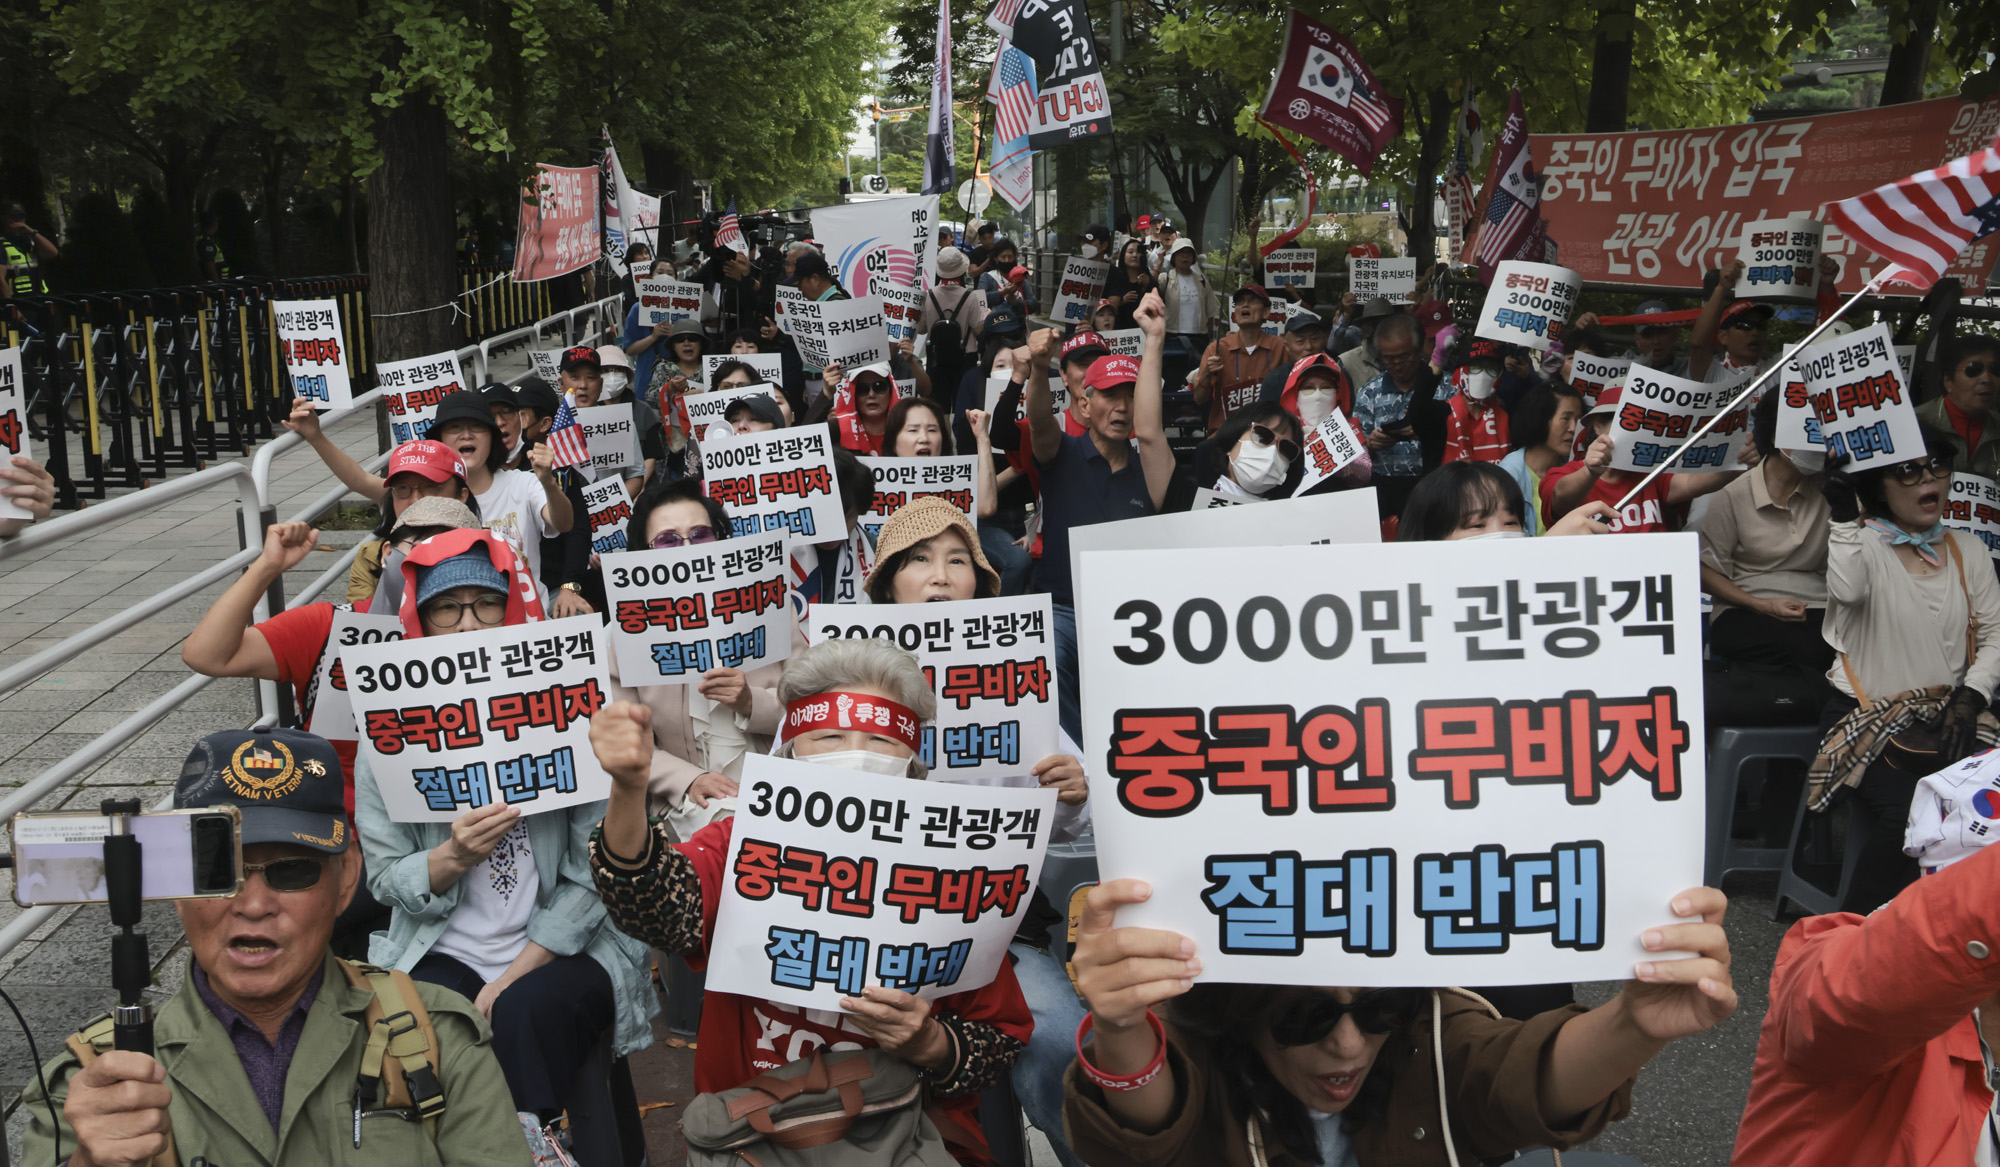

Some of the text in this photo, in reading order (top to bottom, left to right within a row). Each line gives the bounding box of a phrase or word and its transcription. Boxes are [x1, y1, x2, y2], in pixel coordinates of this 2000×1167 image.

[1541, 137, 1625, 202] 중국인
[1622, 130, 1726, 202] 무비자
[1723, 122, 1814, 199] 입국
[1603, 211, 1681, 279] 관광
[1751, 230, 1788, 248] 중국인
[1354, 260, 1379, 269] 중국인
[1755, 249, 1814, 264] 3000만명
[1354, 270, 1415, 280] 관광객 유치보다
[1354, 281, 1379, 291] 자국민
[1505, 273, 1549, 294] 중국인
[1747, 264, 1794, 286] 무비자
[641, 295, 701, 312] 중국인 무비자
[642, 284, 701, 297] 3000만 관광객
[295, 309, 334, 331] 관광객
[787, 301, 822, 319] 중국인
[883, 302, 905, 321] 국인
[1507, 292, 1572, 320] 3000만명
[792, 313, 884, 337] 관광객 유치보다
[1494, 307, 1564, 341] 무비자 반
[293, 337, 341, 366] 무비자
[797, 335, 829, 354] 자국민
[1838, 335, 1890, 374] 관광객
[407, 359, 456, 385] 관광객
[1105, 361, 1118, 371] STOP
[1119, 359, 1128, 367] THE
[296, 374, 330, 403] 반대
[406, 381, 463, 413] 무비자
[1630, 377, 1713, 410] 3000만
[1836, 369, 1903, 418] 무비자
[689, 398, 726, 418] 3000만
[1619, 402, 1694, 439] 중국인
[583, 420, 631, 438] 유치보다
[1846, 419, 1895, 462] 반대
[397, 443, 436, 456] STOP THE
[399, 455, 428, 466] STEAL
[705, 434, 825, 470] 3000만 관광객
[1306, 439, 1338, 478] 무비자
[1331, 432, 1357, 462] 관광객
[1682, 442, 1730, 468] 반대
[709, 464, 833, 507] 중국인 무비자
[921, 463, 973, 484] 관광객
[584, 482, 623, 508] 관광객
[870, 491, 907, 517] 국인
[592, 529, 628, 554] 반대
[611, 540, 784, 588] 3000만 관광객
[616, 592, 709, 634] 중국인
[711, 574, 787, 625] 무비자
[961, 609, 1046, 650] 관광객
[1112, 573, 1675, 666] 3000만 관광객
[355, 630, 596, 694] 3000만 관광객
[651, 624, 767, 676] 절대 반대
[942, 655, 1052, 710] 무비자
[364, 677, 606, 755] 중국인 무비자
[790, 701, 829, 727] 이재명
[855, 703, 891, 727] 투쟁
[943, 720, 1020, 769] 반대
[1107, 686, 1690, 818] 중국인 무비자
[221, 765, 304, 801] VIETNAM VETERAN
[412, 745, 578, 812] 절대 반대
[748, 781, 1042, 851] 3000만 관광객
[292, 831, 337, 848] VIETNAM
[733, 837, 1030, 924] 중국인 무비자
[1200, 839, 1605, 958] 절대 반대
[764, 924, 974, 997] 절대 반대
